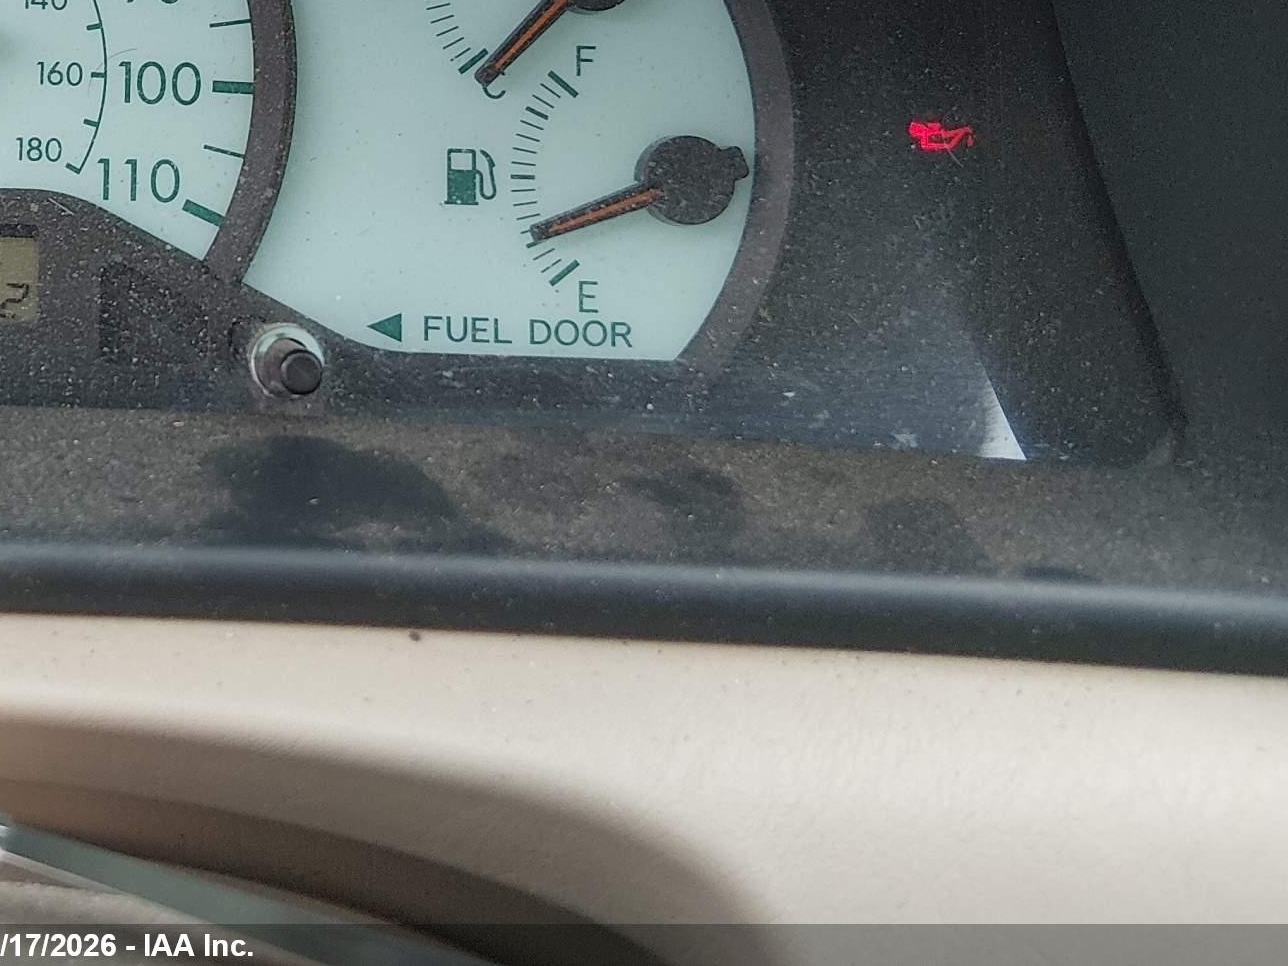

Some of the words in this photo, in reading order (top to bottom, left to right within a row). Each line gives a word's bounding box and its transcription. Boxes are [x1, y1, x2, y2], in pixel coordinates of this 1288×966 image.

[37, 62, 83, 86] 160
[576, 46, 596, 76] F
[119, 62, 201, 105] 100
[16, 137, 62, 162] 180
[97, 158, 180, 203] 110
[579, 281, 598, 313] E
[424, 316, 512, 343] FUEL
[530, 319, 632, 347] DOOR
